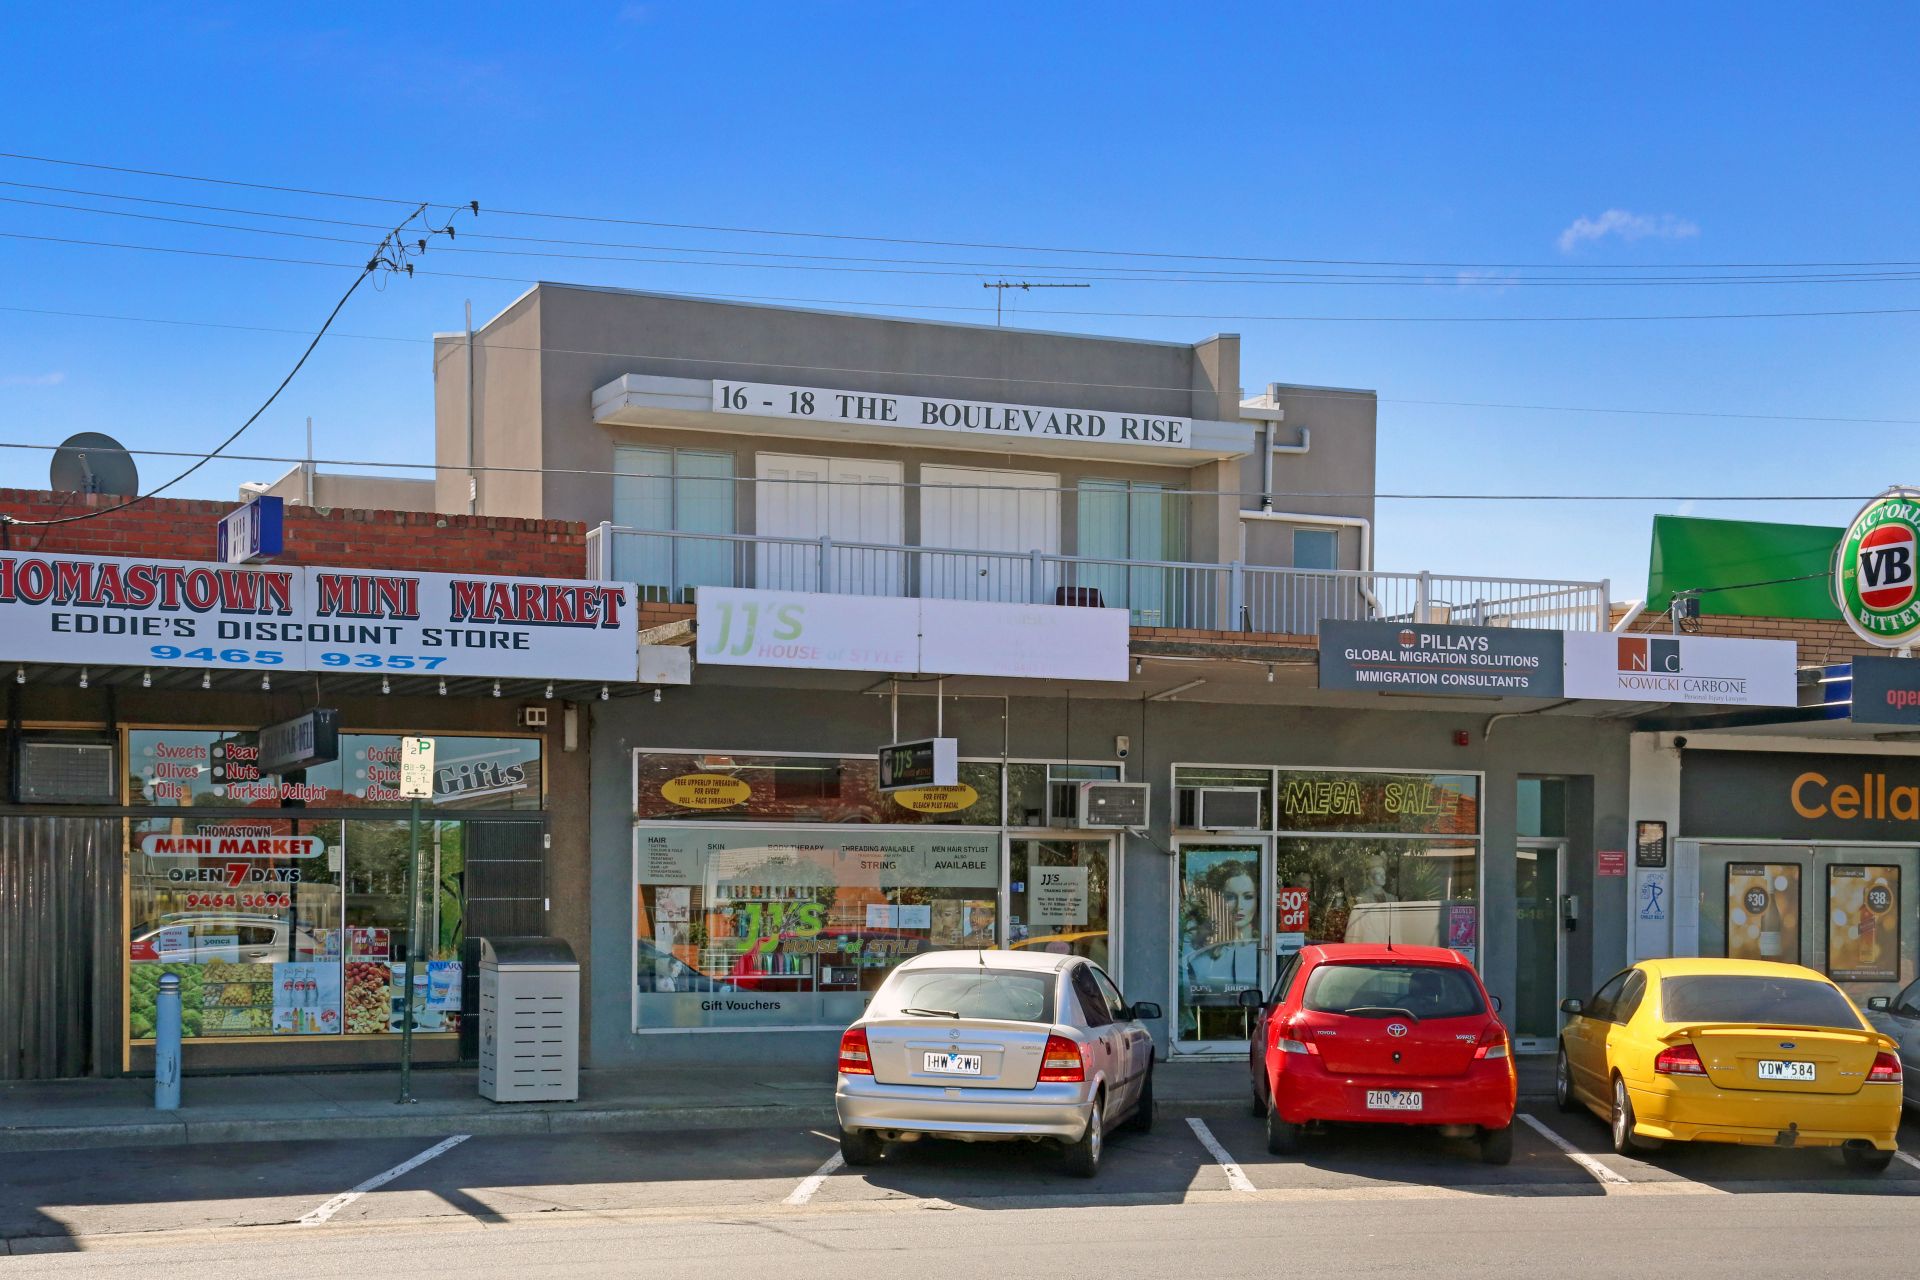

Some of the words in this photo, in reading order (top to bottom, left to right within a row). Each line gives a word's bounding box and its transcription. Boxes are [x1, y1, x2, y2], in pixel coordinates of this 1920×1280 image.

[721, 385, 748, 410] 16
[789, 391, 815, 415] 18
[835, 394, 898, 422] THE
[920, 401, 1106, 437] BOULEVARD
[1120, 417, 1183, 444] RISE
[1860, 546, 1911, 587] VB
[316, 573, 421, 621] MINI
[449, 579, 627, 629] MARKET
[51, 612, 196, 638] EDDIE'S
[217, 620, 403, 645] DISCOUNT
[422, 628, 530, 650] STORE
[705, 601, 806, 657] JJ'S
[1420, 634, 1489, 651] PILLAYS
[150, 645, 284, 665] 9465
[320, 652, 447, 670] 9357
[757, 645, 819, 661] HOUSE
[849, 649, 905, 665] STYLE
[1344, 649, 1397, 662] GLOBAL
[1400, 651, 1467, 665] MIGRATION
[1470, 654, 1539, 667] SOLUTIONS
[1632, 653, 1647, 670] N
[1356, 670, 1438, 685] IMMIGRATION
[1441, 673, 1529, 688] CONSULTANTS
[1618, 676, 1679, 692] NOWICKI
[1684, 679, 1747, 694] CARBONE
[156, 742, 206, 760] Sweets
[156, 763, 199, 779] Olives
[226, 763, 260, 780] Nuts
[434, 761, 525, 795] Gifts
[156, 782, 183, 799] Oils
[674, 778, 687, 787] FREE
[688, 779, 712, 787] UPPERLIP
[712, 779, 740, 787] THREADING
[694, 787, 704, 795] FOR
[705, 787, 720, 795] EVERY
[226, 783, 277, 800] Turkish
[280, 783, 327, 802] Delight
[695, 797, 707, 805] FACE
[708, 797, 736, 805] THREADING
[923, 793, 933, 801] FOR
[934, 793, 948, 801] EVERY
[1285, 781, 1361, 815] MEGA
[1384, 783, 1462, 815] SALE
[1791, 772, 1920, 821] Cella
[198, 825, 271, 838] THOMASTOWN
[154, 838, 211, 854] MINI
[218, 839, 314, 854] MARKET
[790, 844, 825, 852] THERAPY
[860, 861, 897, 870] STRING
[934, 861, 987, 870] AVAILABLE
[168, 867, 225, 883] OPEN
[226, 863, 251, 888] 7
[250, 867, 301, 883] DAYS
[186, 892, 237, 908] 9464
[242, 893, 291, 909] 3696
[1281, 891, 1308, 911] 50%
[1748, 893, 1765, 906] $30
[1870, 892, 1887, 905] $38
[1284, 911, 1305, 925] off
[783, 939, 838, 953] HOUSE
[846, 938, 864, 953] of
[866, 939, 919, 953] STYLE
[701, 1001, 722, 1011] Gift
[728, 1000, 781, 1011] Vouchers
[1760, 1062, 1783, 1075] YDW
[1791, 1064, 1813, 1076] 584
[1368, 1092, 1390, 1105] ZHQ
[1399, 1093, 1420, 1106] 260
